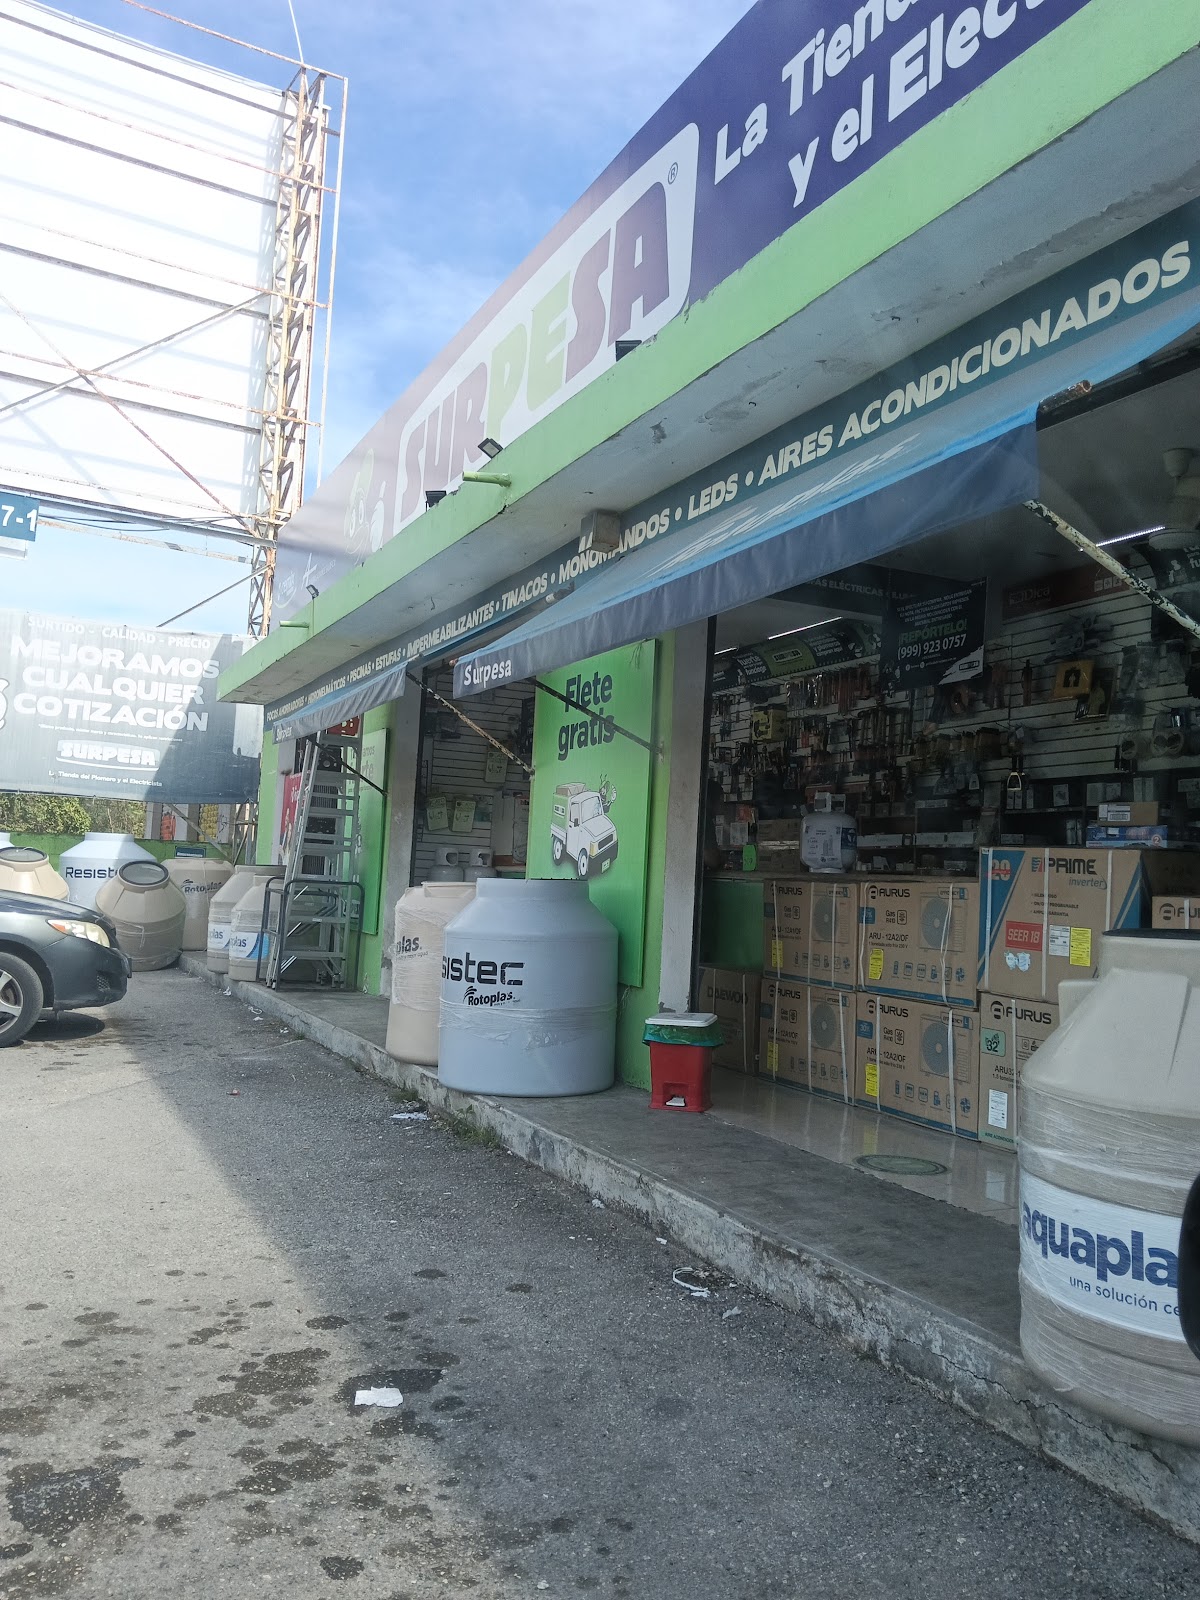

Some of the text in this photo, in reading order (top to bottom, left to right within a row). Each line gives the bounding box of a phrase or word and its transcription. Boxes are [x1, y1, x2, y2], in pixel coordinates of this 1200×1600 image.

[714, 0, 919, 185] La Tien
[788, 0, 1045, 208] y el Elec
[400, 181, 670, 523] SURPESA
[349, 661, 372, 683] PISCINAS
[375, 648, 402, 671] ESTUFAS
[407, 600, 495, 657] IMPERMEABILIZANTES
[501, 573, 548, 612] TINACOS
[687, 473, 738, 521] LEDS
[757, 425, 833, 486] AIRES
[838, 240, 1191, 447] ACONDICIONADOS
[828, 579, 884, 597] ELÉCTRICAS
[28, 615, 211, 649] SURTIDO CALIDAD PRECIO
[10, 634, 220, 679] MEJORAMOS
[897, 643, 921, 660] (999)
[923, 640, 940, 654] 923
[942, 633, 967, 650] 0757
[22, 666, 205, 705] CUALQUIER
[463, 659, 512, 688] Surpesa
[564, 671, 613, 713] Flete
[13, 692, 209, 732] COTIZACIÓN
[557, 707, 616, 762] gratis
[60, 743, 157, 766] SURPESA
[58, 770, 80, 779] Tienda
[91, 774, 116, 783] Plomero
[130, 778, 163, 787] Electricista
[65, 866, 118, 879] Resist
[1043, 857, 1098, 876] PRIME
[778, 886, 803, 896] AURUS
[879, 888, 911, 898] AURUS
[1068, 876, 1104, 888] inverter
[885, 909, 896, 917] Gas
[1007, 928, 1029, 943] SEER
[1030, 930, 1040, 944] 18
[468, 991, 514, 1007] Rotoplas
[879, 1003, 909, 1018] AURUS
[1006, 1006, 1052, 1025] AURUS
[883, 1027, 893, 1036] Gas
[1022, 1201, 1179, 1289] aquapla
[1069, 1276, 1091, 1293] una
[1095, 1286, 1158, 1312] solución
